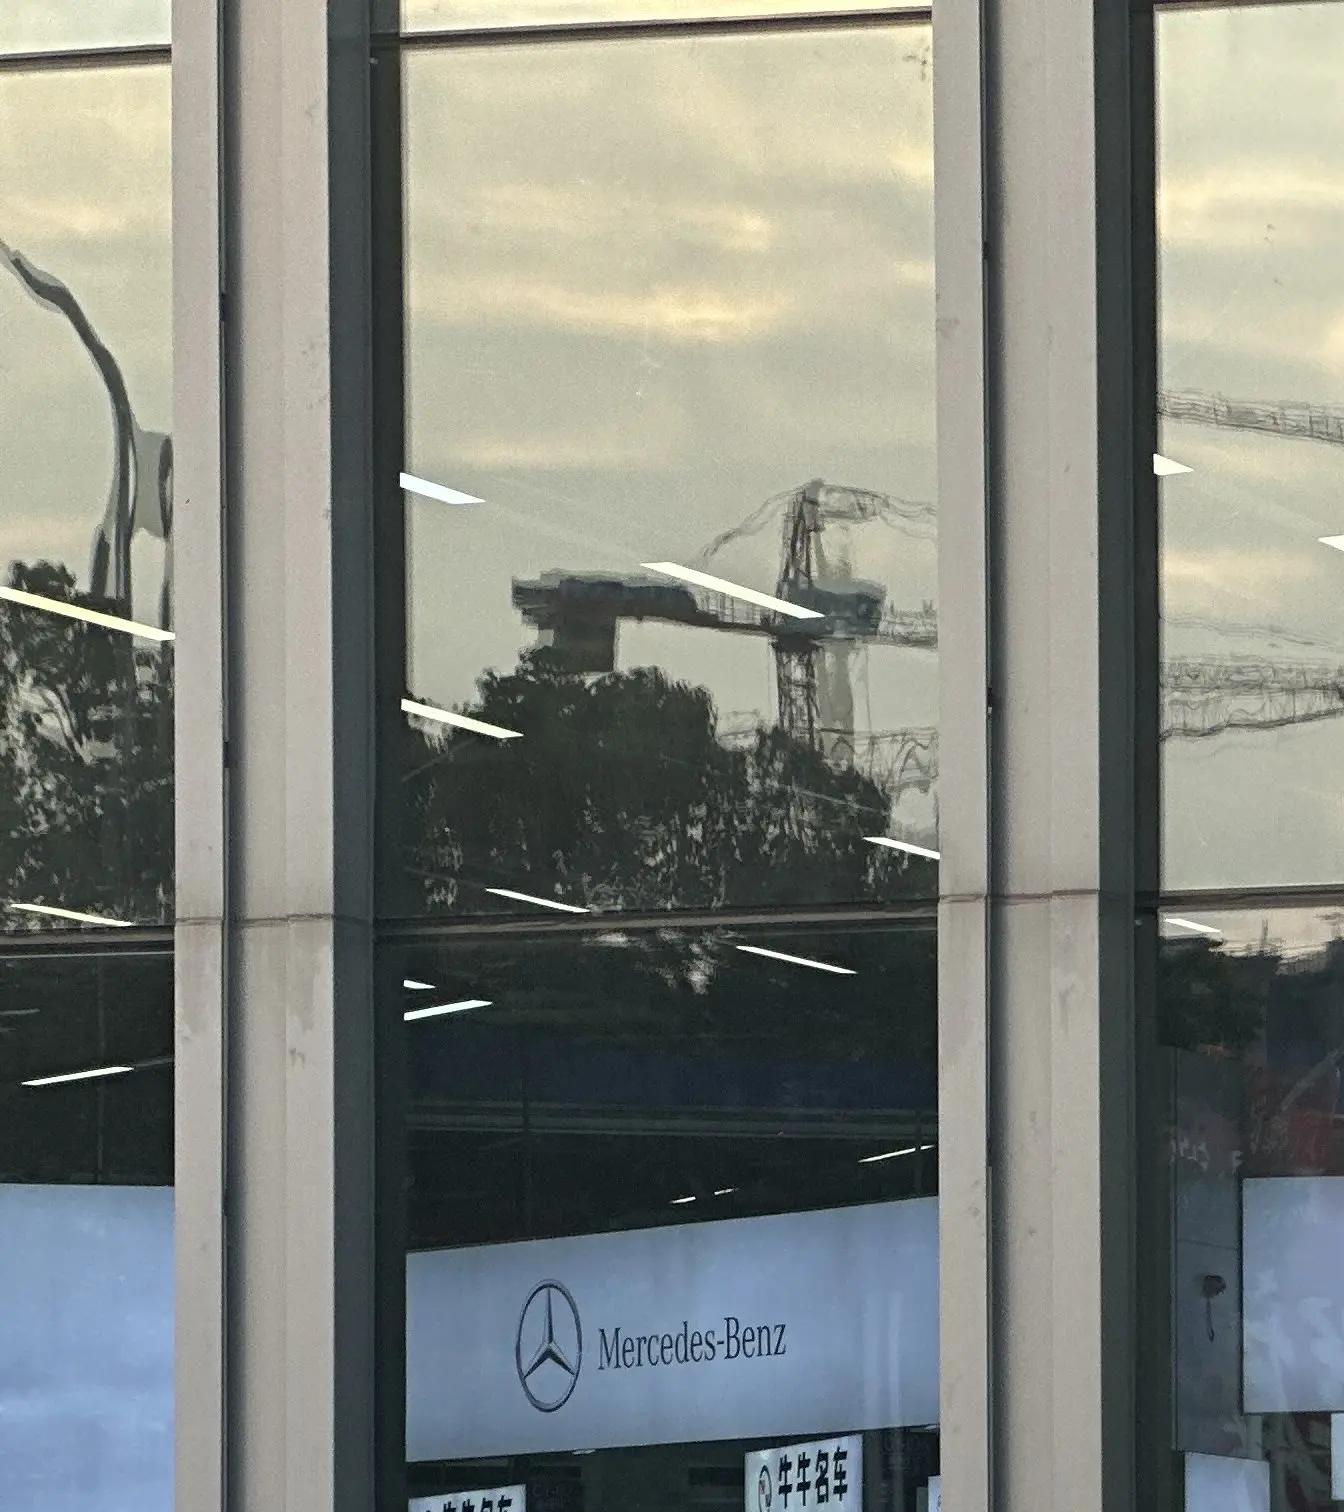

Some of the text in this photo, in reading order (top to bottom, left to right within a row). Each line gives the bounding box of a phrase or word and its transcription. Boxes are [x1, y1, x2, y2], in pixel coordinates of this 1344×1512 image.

[598, 1316, 787, 1371] Mercedes-Benz
[778, 1445, 848, 1510] 牛牛名车
